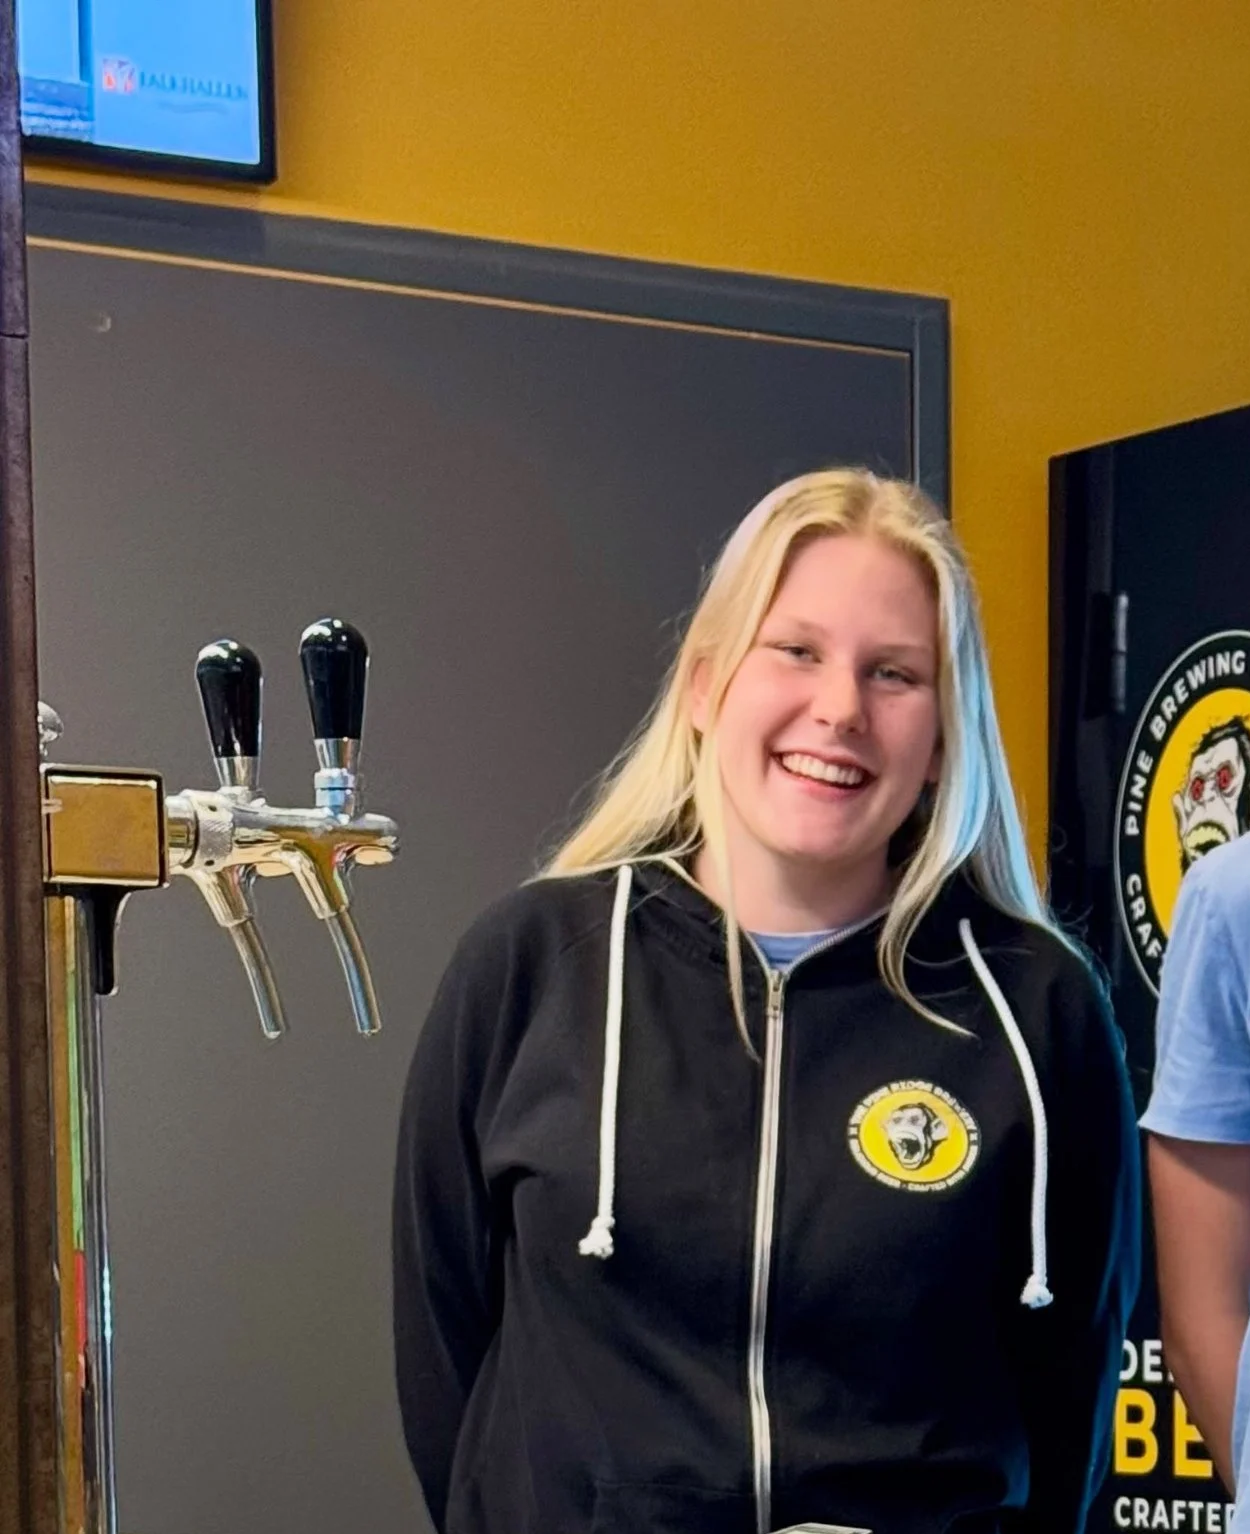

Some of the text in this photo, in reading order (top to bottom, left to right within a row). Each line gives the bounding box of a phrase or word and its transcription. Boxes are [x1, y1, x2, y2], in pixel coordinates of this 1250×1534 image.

[1125, 749, 1155, 836] PINE
[1148, 649, 1247, 742] BREWING
[1126, 873, 1164, 976] CRAF
[1113, 1496, 1234, 1533] CRAFTE
